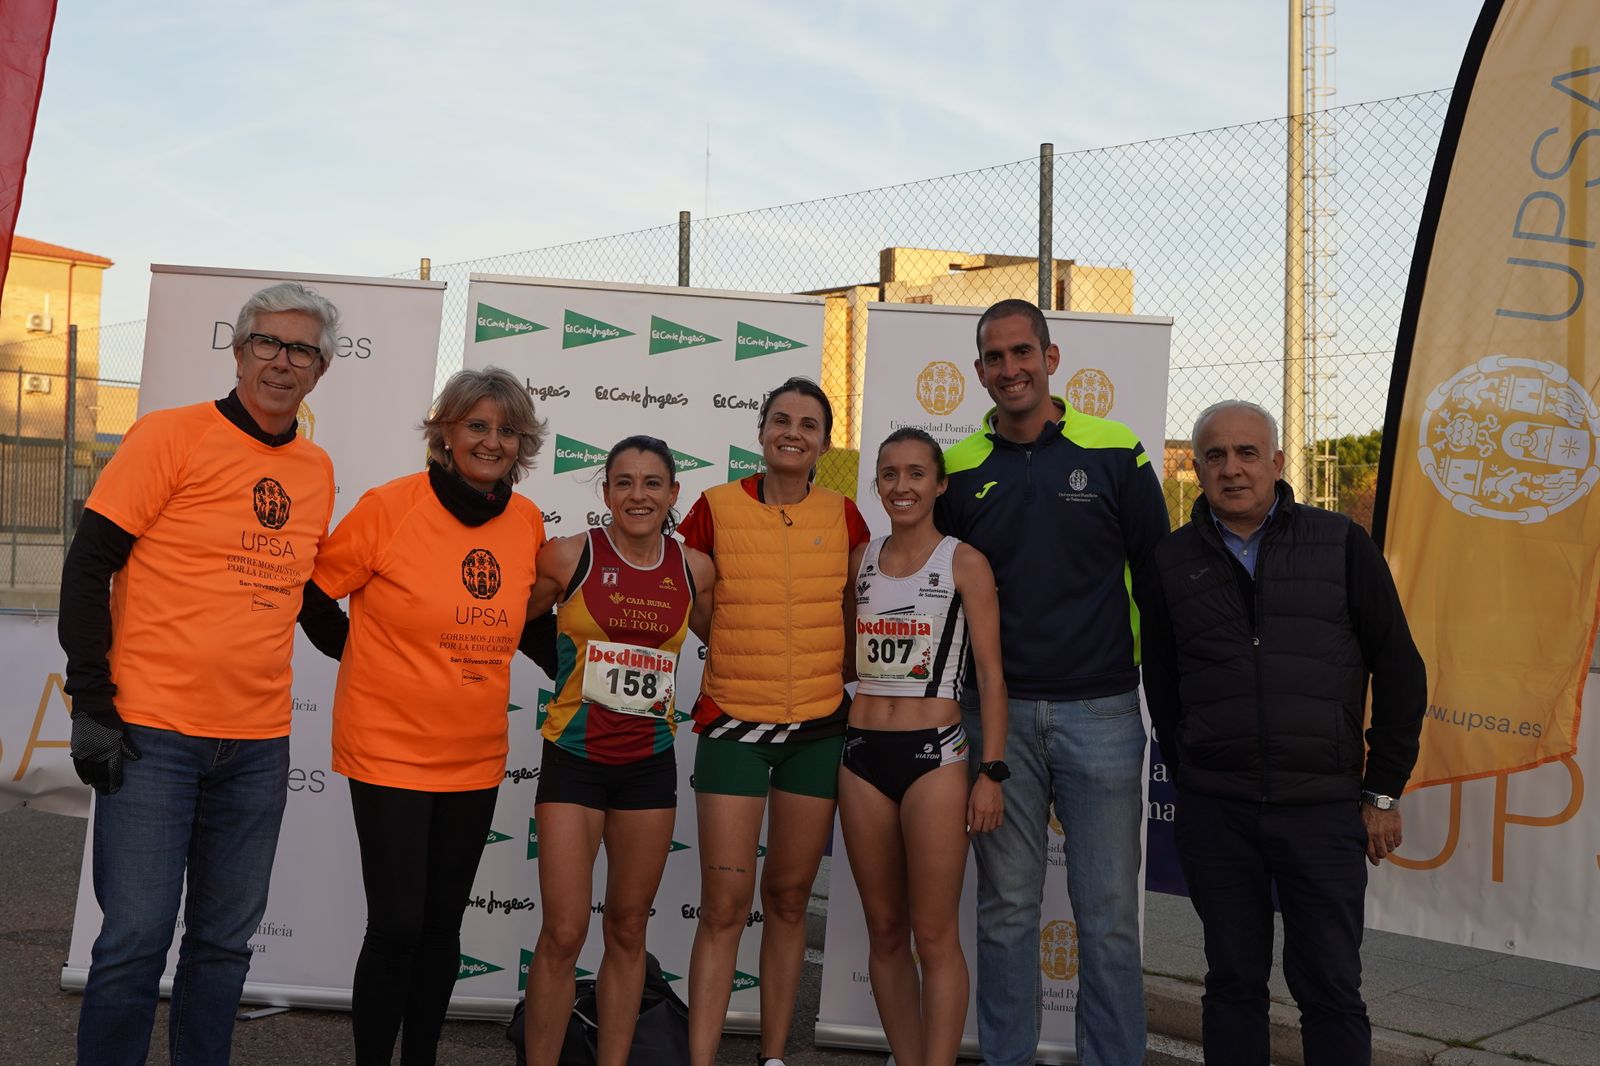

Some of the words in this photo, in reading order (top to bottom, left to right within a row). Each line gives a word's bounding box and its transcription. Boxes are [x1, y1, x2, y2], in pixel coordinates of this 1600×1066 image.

[478, 317, 486, 326] El
[486, 318, 504, 328] Corte
[506, 318, 533, 332] Inglés
[565, 324, 573, 333] El
[574, 325, 592, 334] Corte
[592, 324, 620, 338] Inglés
[652, 330, 660, 339] El
[660, 331, 678, 340] Corte
[678, 330, 706, 344] Inglés
[737, 335, 745, 344] El
[746, 337, 764, 346] Corte
[765, 336, 792, 350] Inglés
[594, 386, 609, 400] El
[609, 387, 641, 403] Corte
[642, 386, 688, 409] Inglés
[713, 394, 726, 408] El
[727, 395, 759, 410] Corte
[556, 449, 564, 458] El
[564, 450, 584, 459] Corte
[586, 512, 600, 526] El
[241, 530, 296, 560] UPSA
[227, 554, 275, 572] CORREMOS
[227, 564, 245, 574] POR
[245, 568, 257, 577] LA
[456, 606, 508, 627] UPSA
[622, 608, 658, 621] VINO
[609, 617, 627, 628] DE
[630, 620, 669, 634] TORO
[857, 618, 931, 636] bedunia
[439, 641, 456, 650] POR
[440, 633, 486, 642] CORREMOS
[488, 636, 513, 644] JUNTOS
[867, 638, 914, 664] 307
[588, 644, 673, 674] bedunia
[606, 668, 657, 699] 158
[487, 890, 535, 914] Inglés
[681, 904, 695, 919] El
